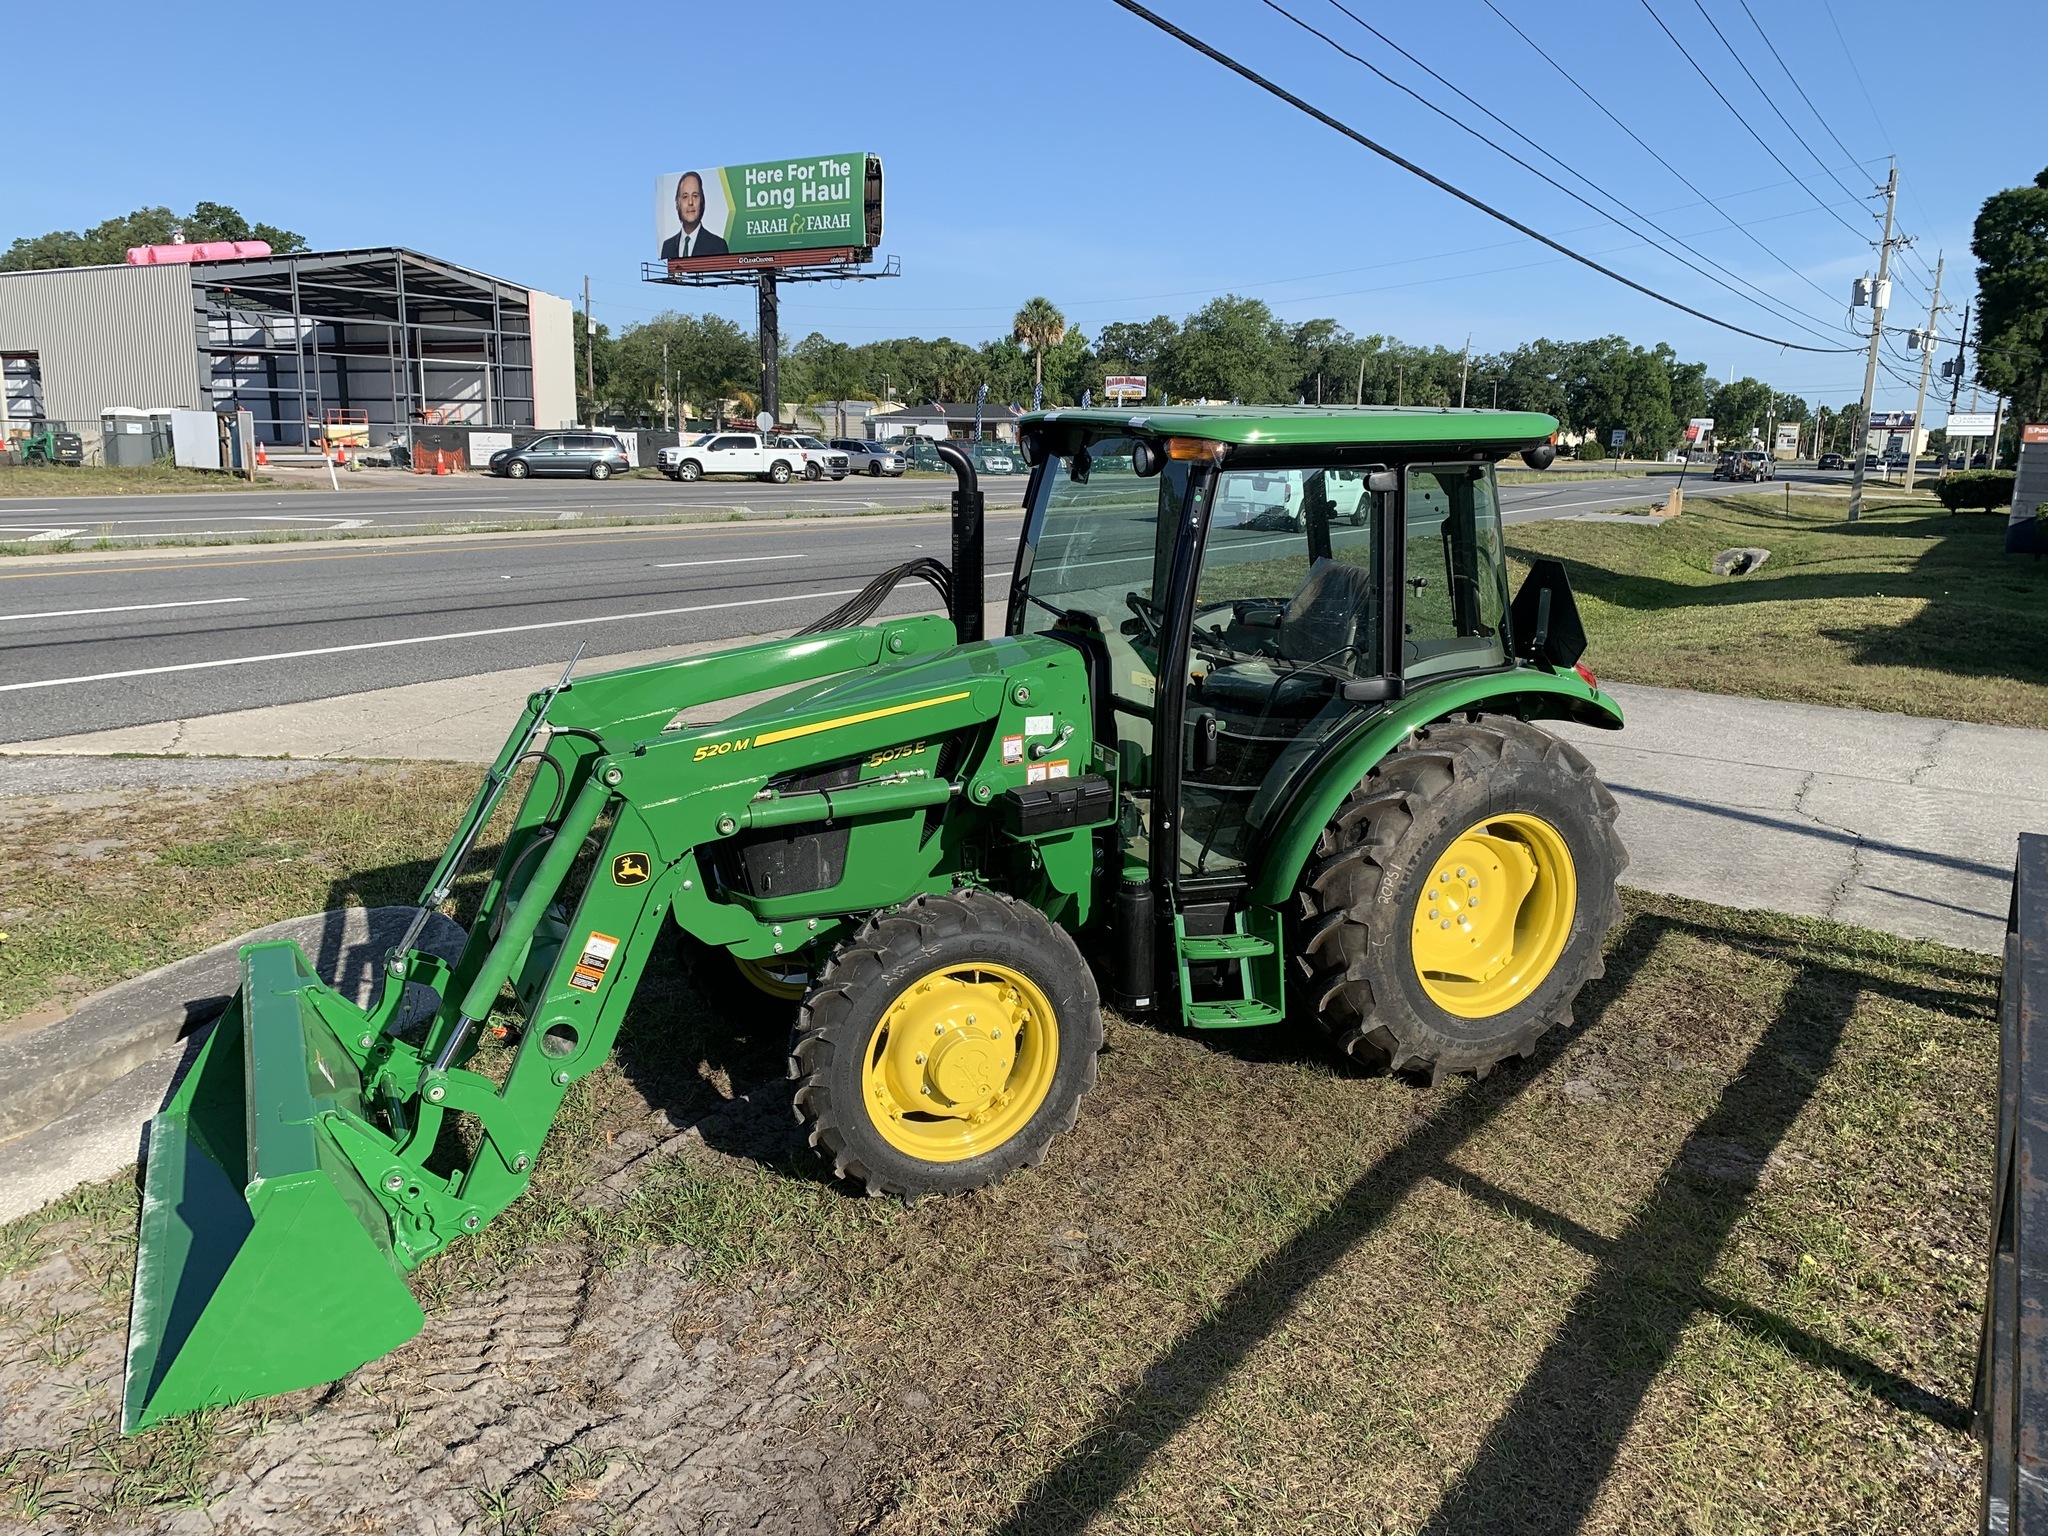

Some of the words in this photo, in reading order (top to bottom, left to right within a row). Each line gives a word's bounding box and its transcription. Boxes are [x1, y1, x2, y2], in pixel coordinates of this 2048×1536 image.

[745, 168, 783, 186] Here
[788, 164, 815, 181] For
[819, 159, 851, 178] The
[746, 187, 795, 209] Long
[802, 177, 850, 203] Haul
[746, 218, 787, 235] FARAH
[789, 213, 806, 235] &
[806, 213, 851, 231] FARAH
